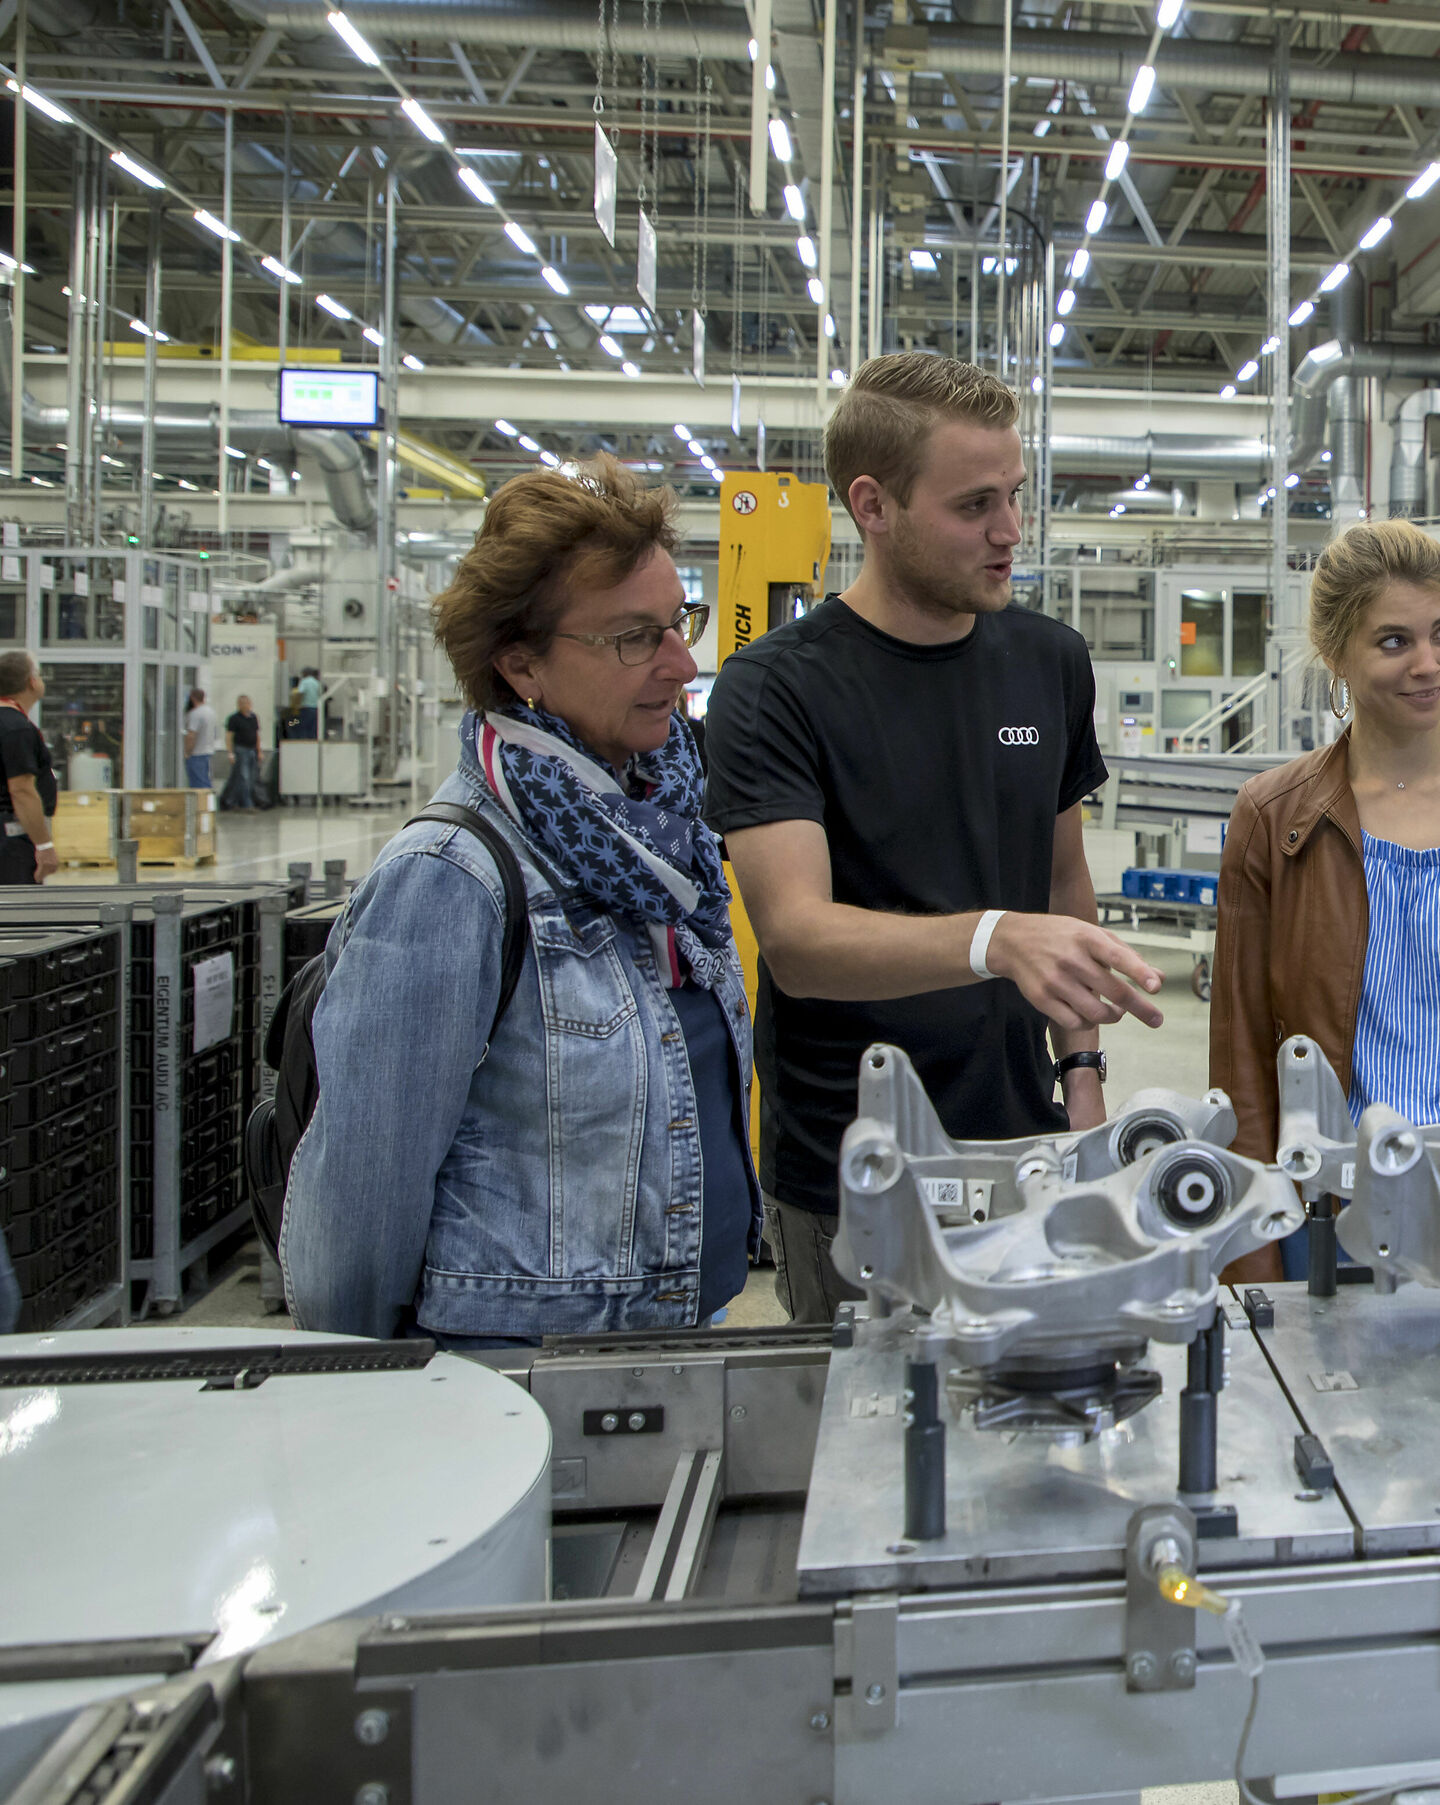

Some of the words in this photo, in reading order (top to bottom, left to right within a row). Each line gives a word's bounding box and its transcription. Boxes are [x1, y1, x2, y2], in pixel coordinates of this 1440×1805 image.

[157, 976, 170, 1048] EIGENTUM
[156, 1053, 169, 1087] AUDI
[156, 1092, 168, 1112] AG
